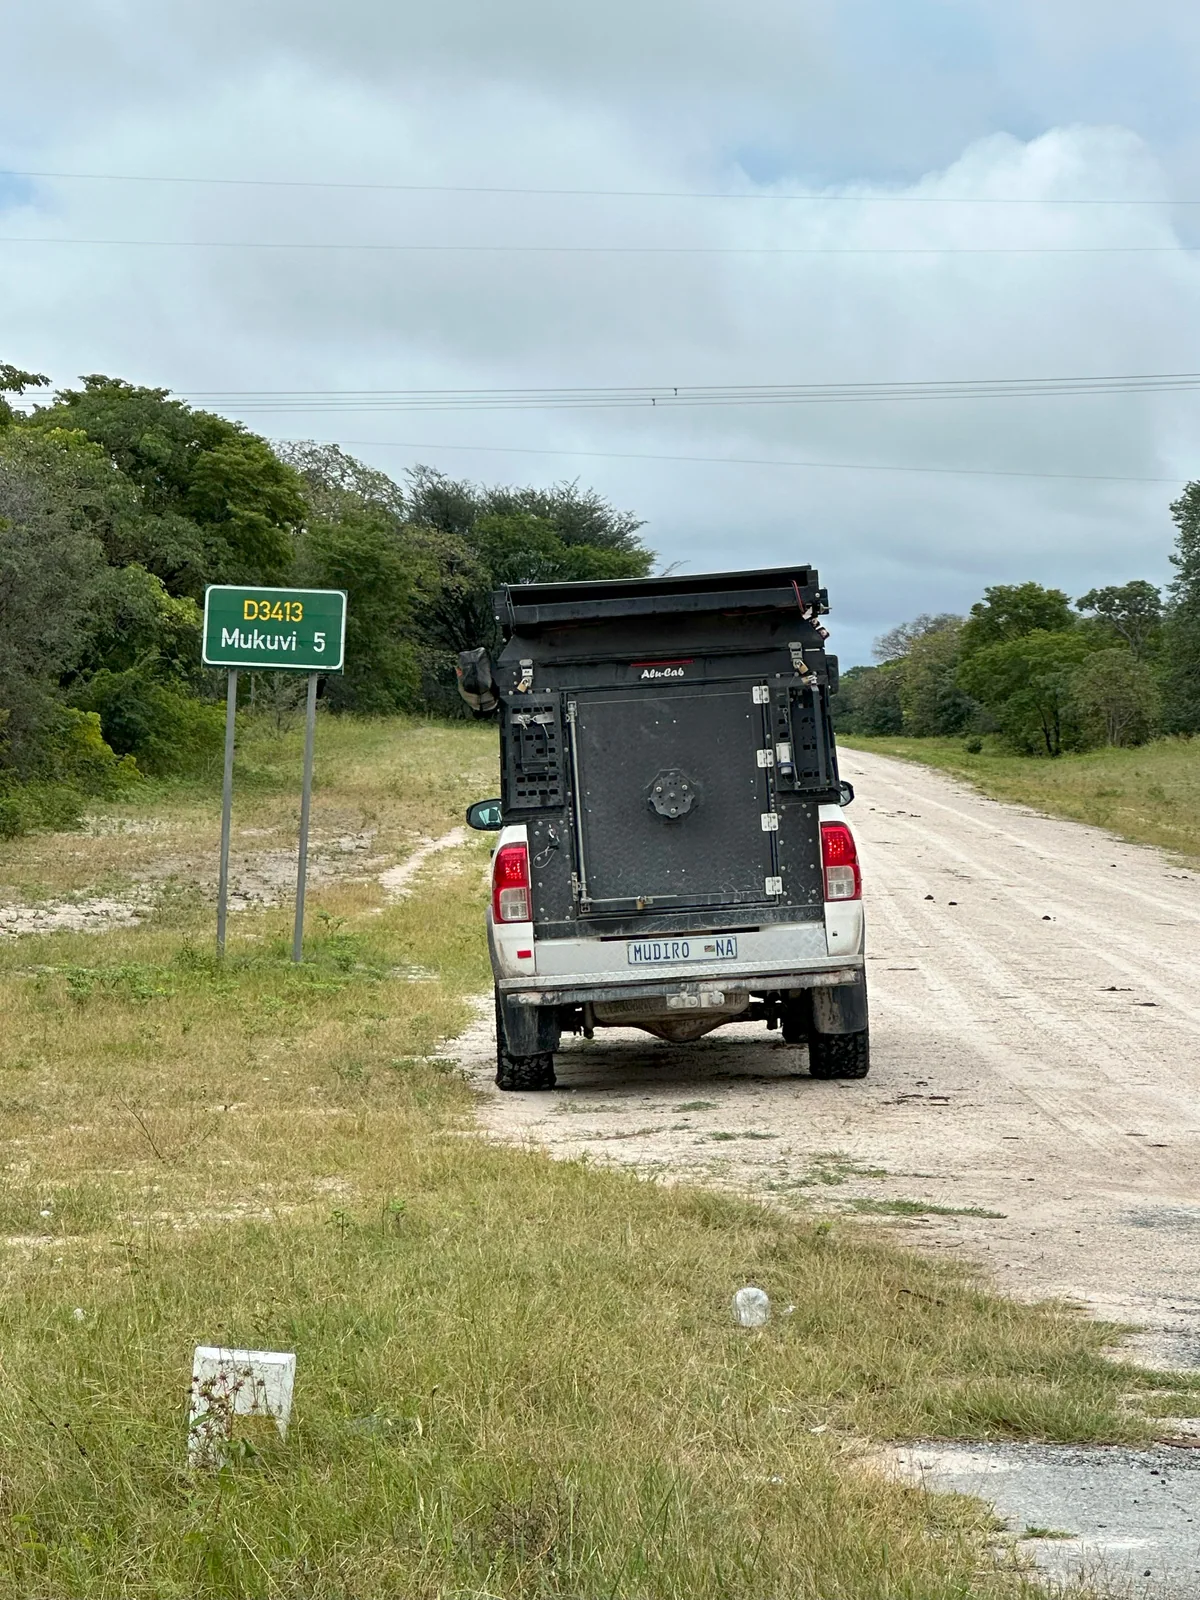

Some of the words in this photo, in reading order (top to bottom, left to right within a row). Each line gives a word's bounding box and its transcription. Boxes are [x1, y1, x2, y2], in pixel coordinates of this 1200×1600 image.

[243, 600, 303, 622] D3413
[221, 627, 297, 651] Mukuvi
[313, 632, 326, 652] 5
[641, 667, 684, 679] Alu-Cab
[634, 942, 690, 961] MUDIRO
[716, 939, 734, 956] NA
